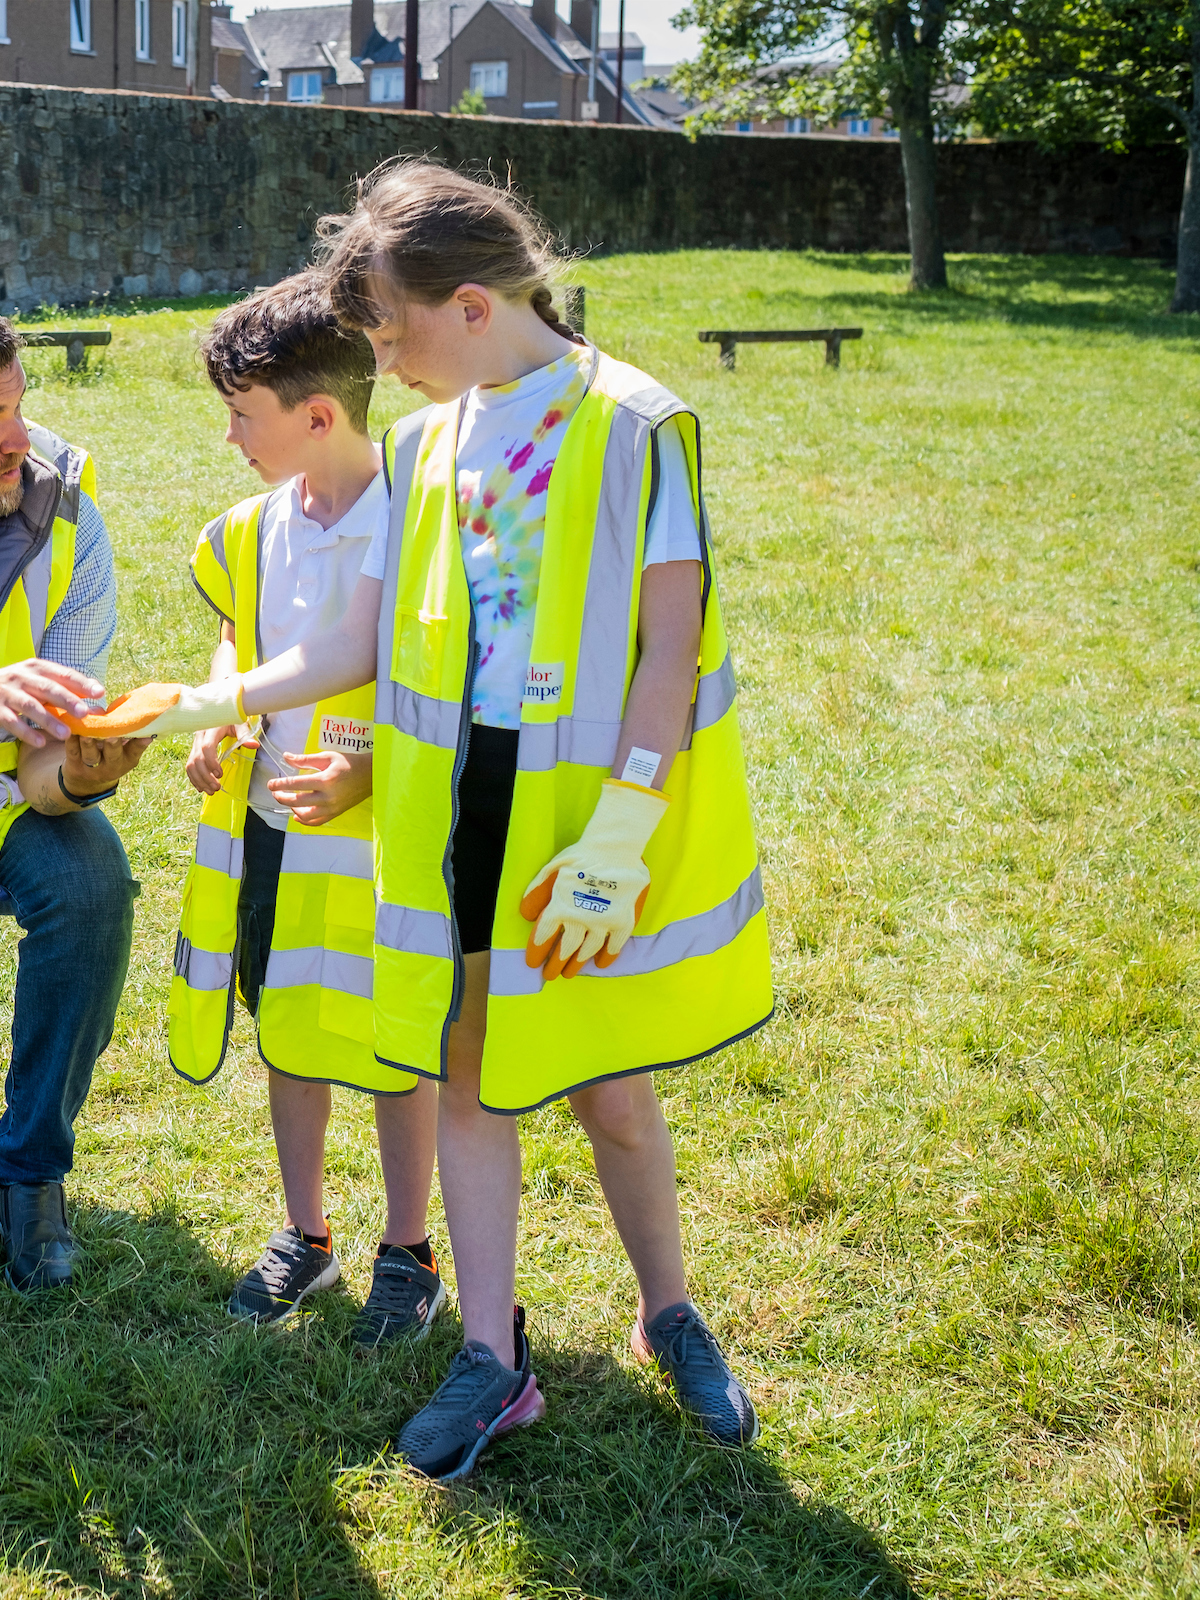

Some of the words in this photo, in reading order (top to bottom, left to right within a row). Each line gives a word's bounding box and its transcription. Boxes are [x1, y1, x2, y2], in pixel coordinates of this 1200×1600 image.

[323, 719, 369, 736] Taylor
[323, 731, 374, 752] Wimpe
[574, 897, 608, 913] JUBA
